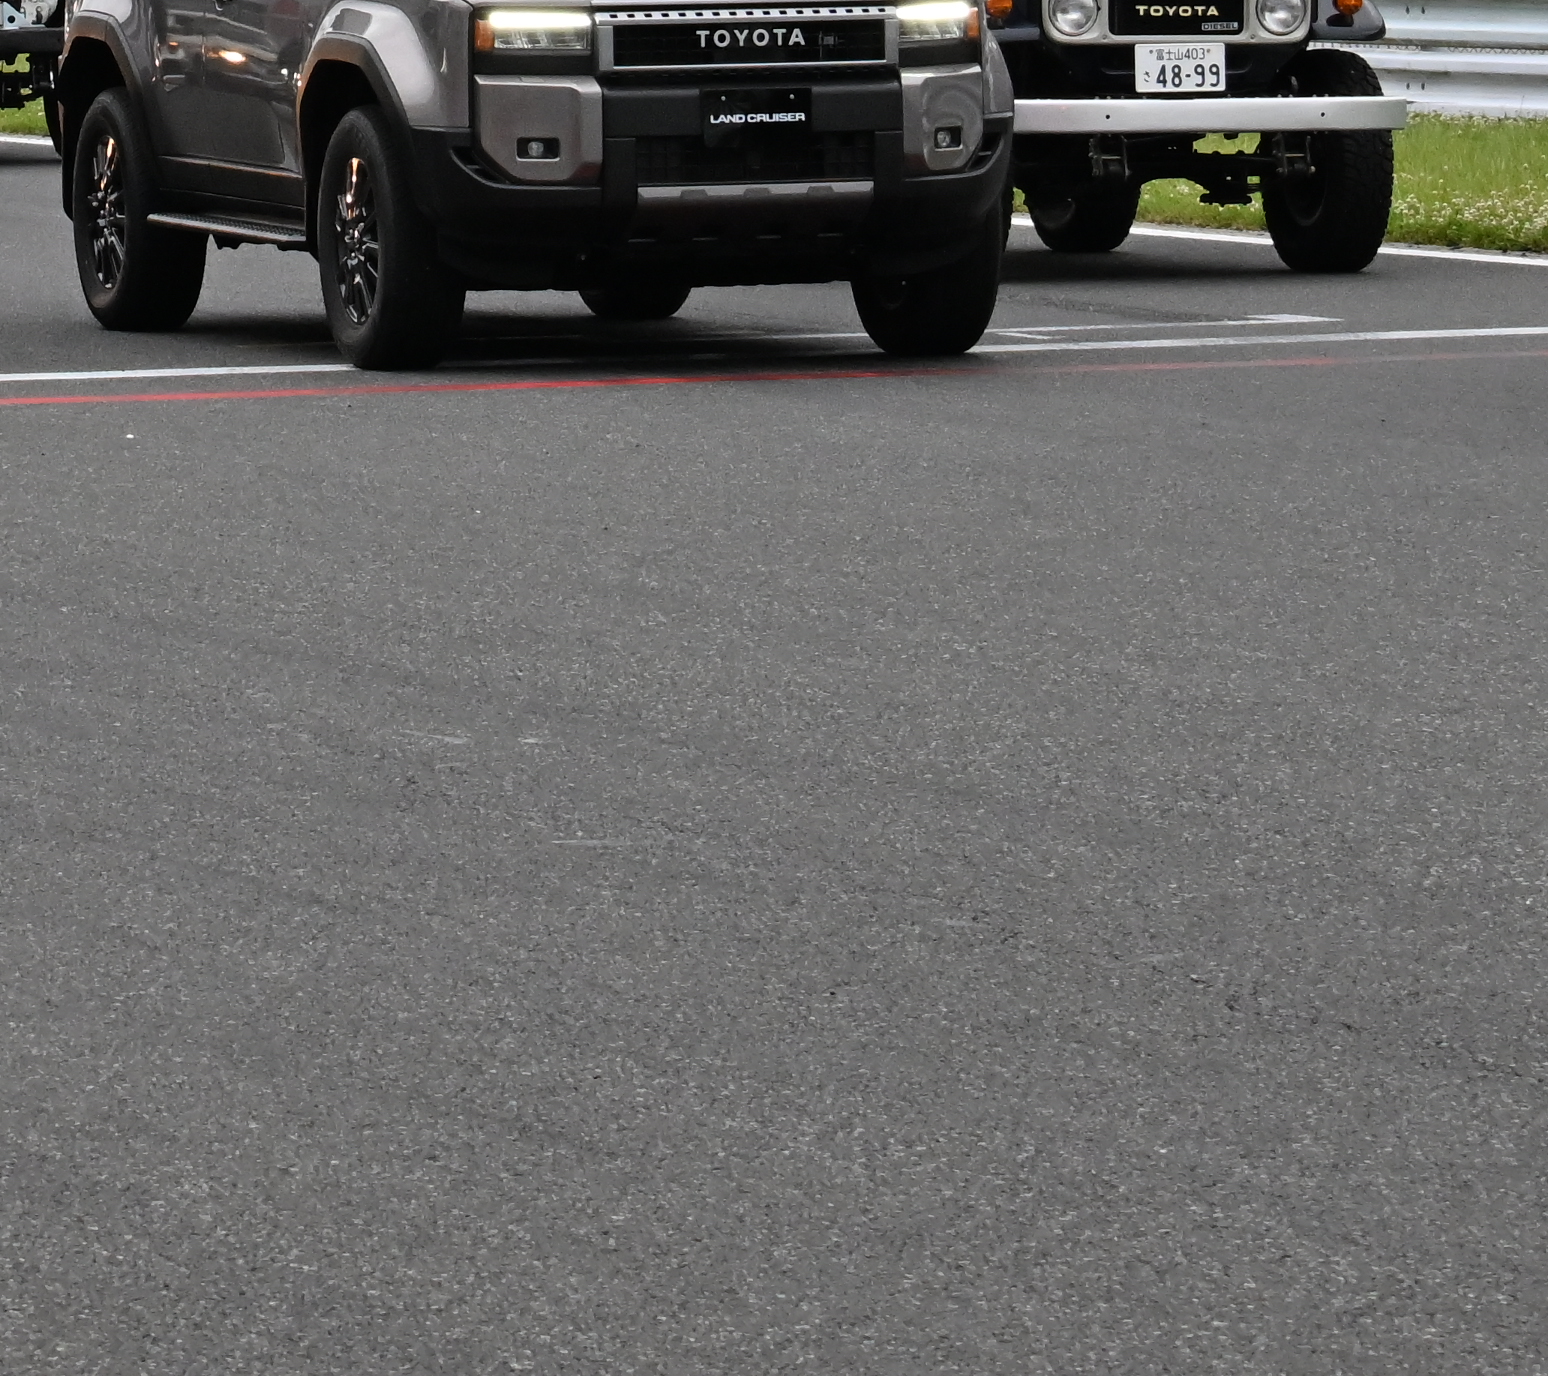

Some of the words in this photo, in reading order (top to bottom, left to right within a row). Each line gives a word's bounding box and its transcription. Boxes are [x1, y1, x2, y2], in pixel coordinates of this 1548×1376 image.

[1135, 5, 1220, 16] TOYOTA
[1202, 22, 1238, 30] DIESEL
[696, 28, 806, 48] TOYOTA
[1143, 70, 1151, 83] さ
[1156, 63, 1220, 88] 48-99
[710, 114, 745, 124] LAND
[747, 112, 806, 123] CRUISER
